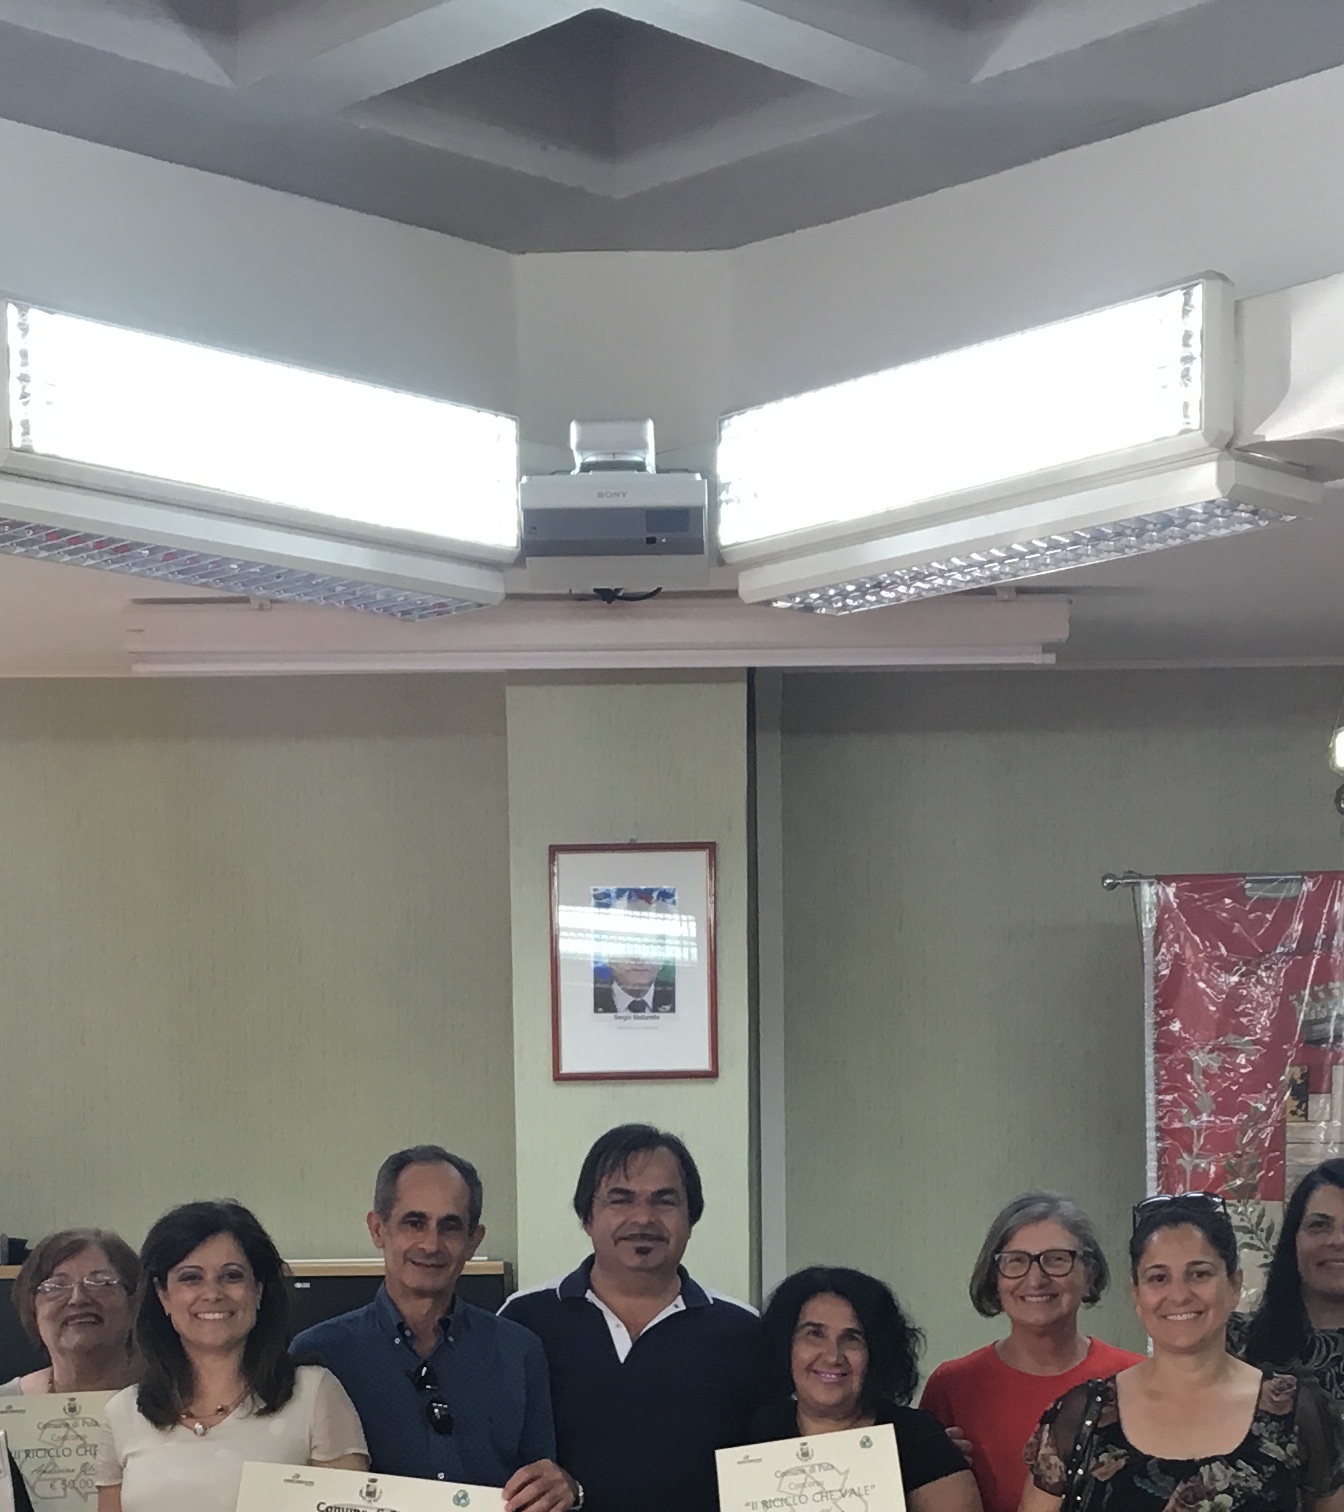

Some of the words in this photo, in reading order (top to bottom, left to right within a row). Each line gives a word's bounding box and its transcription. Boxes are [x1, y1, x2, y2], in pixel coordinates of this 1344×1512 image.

[597, 491, 628, 499] SONY
[25, 1448, 72, 1459] RICICLO
[761, 1494, 807, 1509] RICICLO
[812, 1491, 835, 1502] CHE
